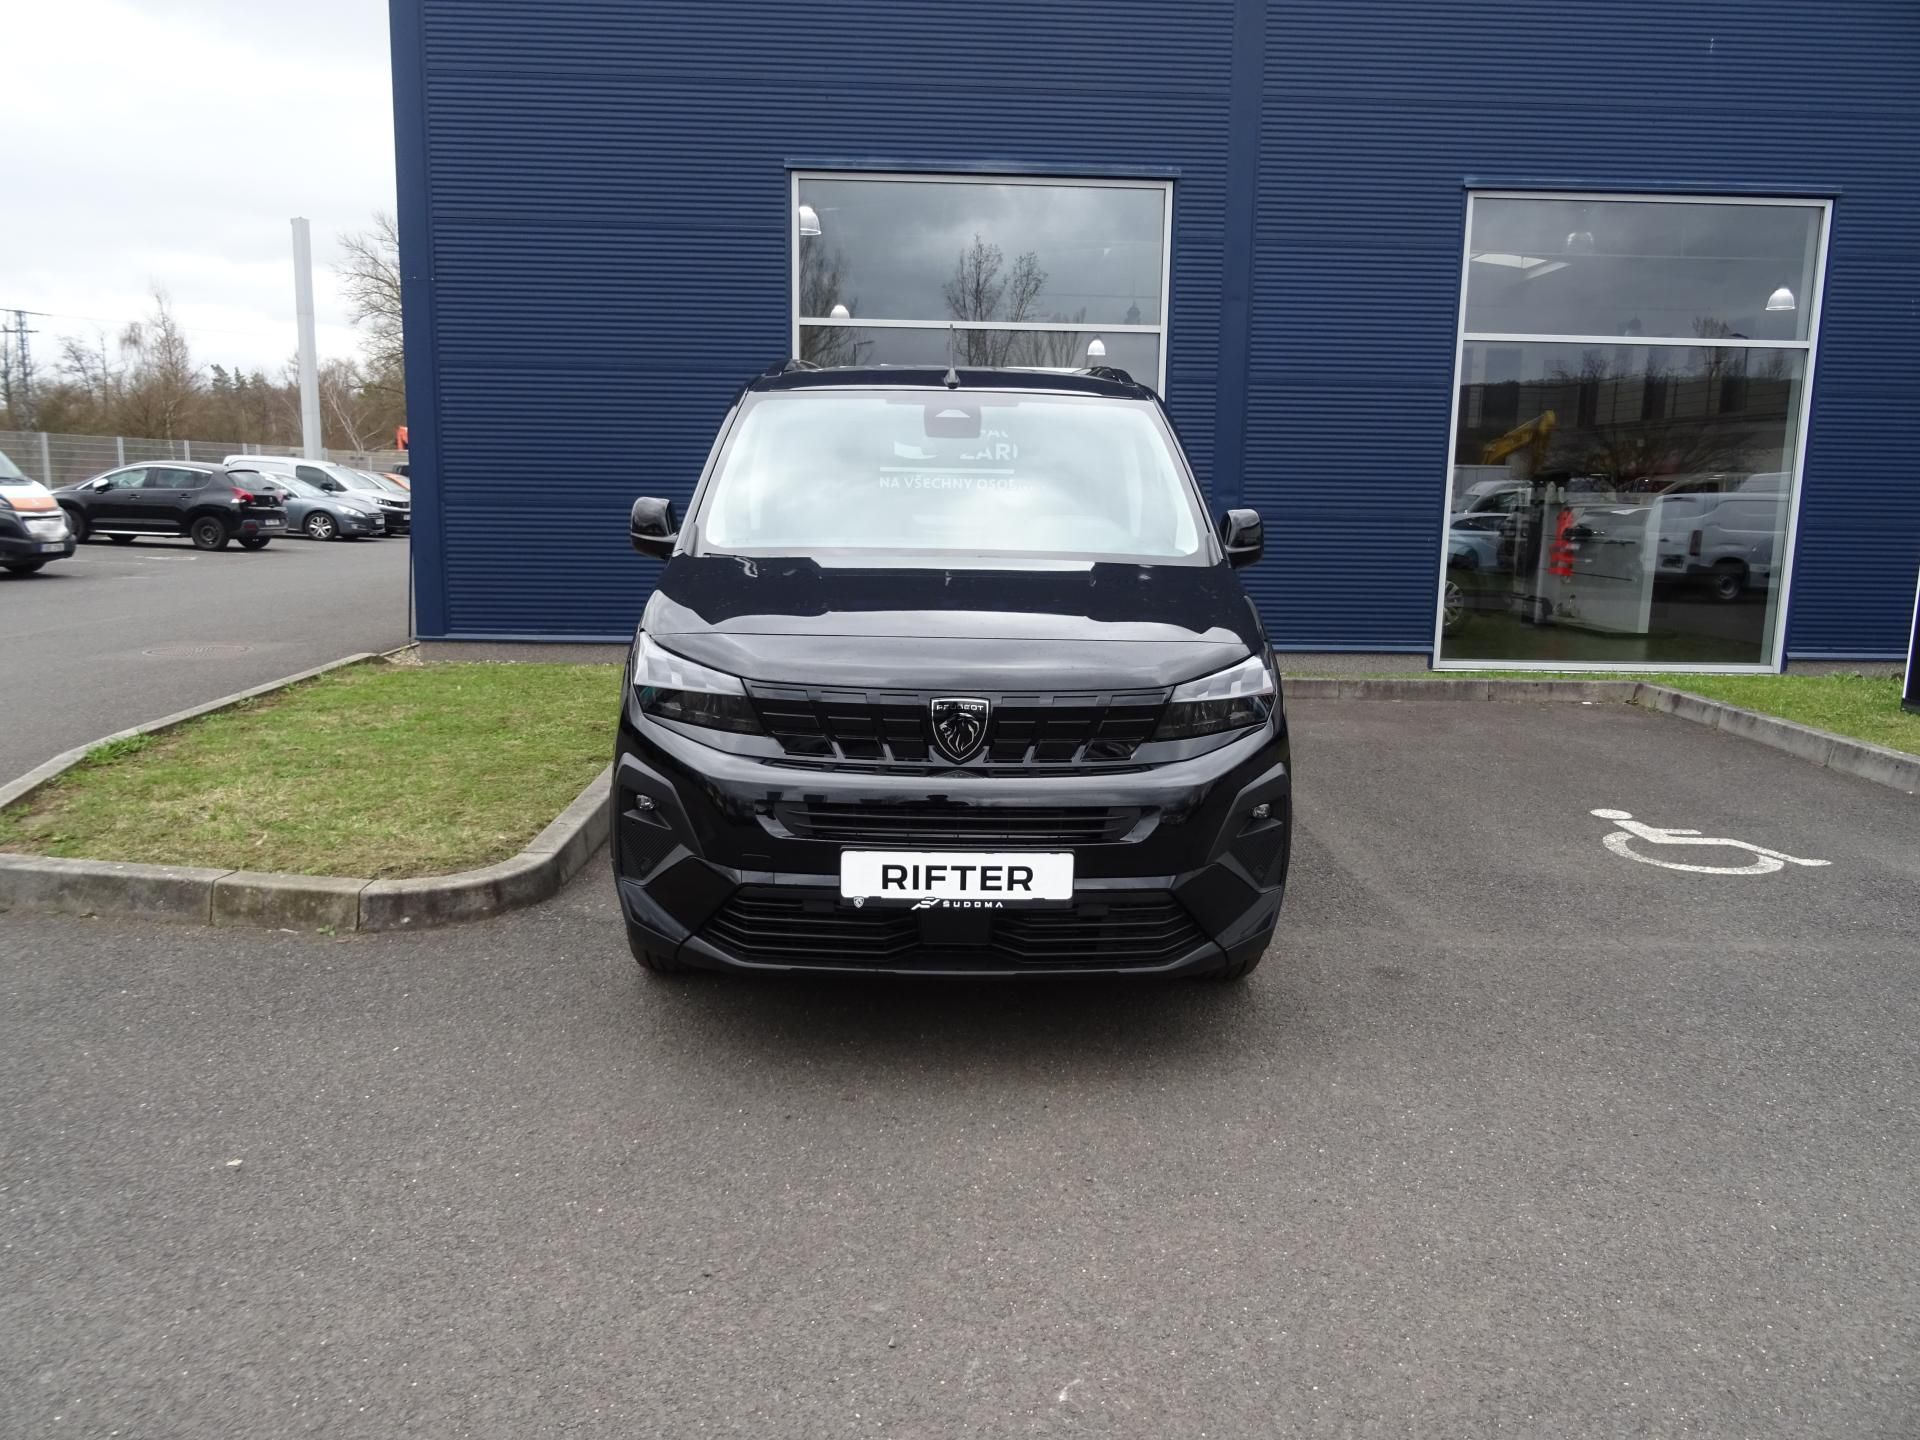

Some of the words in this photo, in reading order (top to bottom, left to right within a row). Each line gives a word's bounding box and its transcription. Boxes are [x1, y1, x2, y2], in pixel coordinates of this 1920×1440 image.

[879, 476, 900, 489] NA
[903, 474, 973, 490] VŠECHNY
[881, 864, 1034, 892] RIFTER
[942, 901, 1004, 909] SUDOMA
